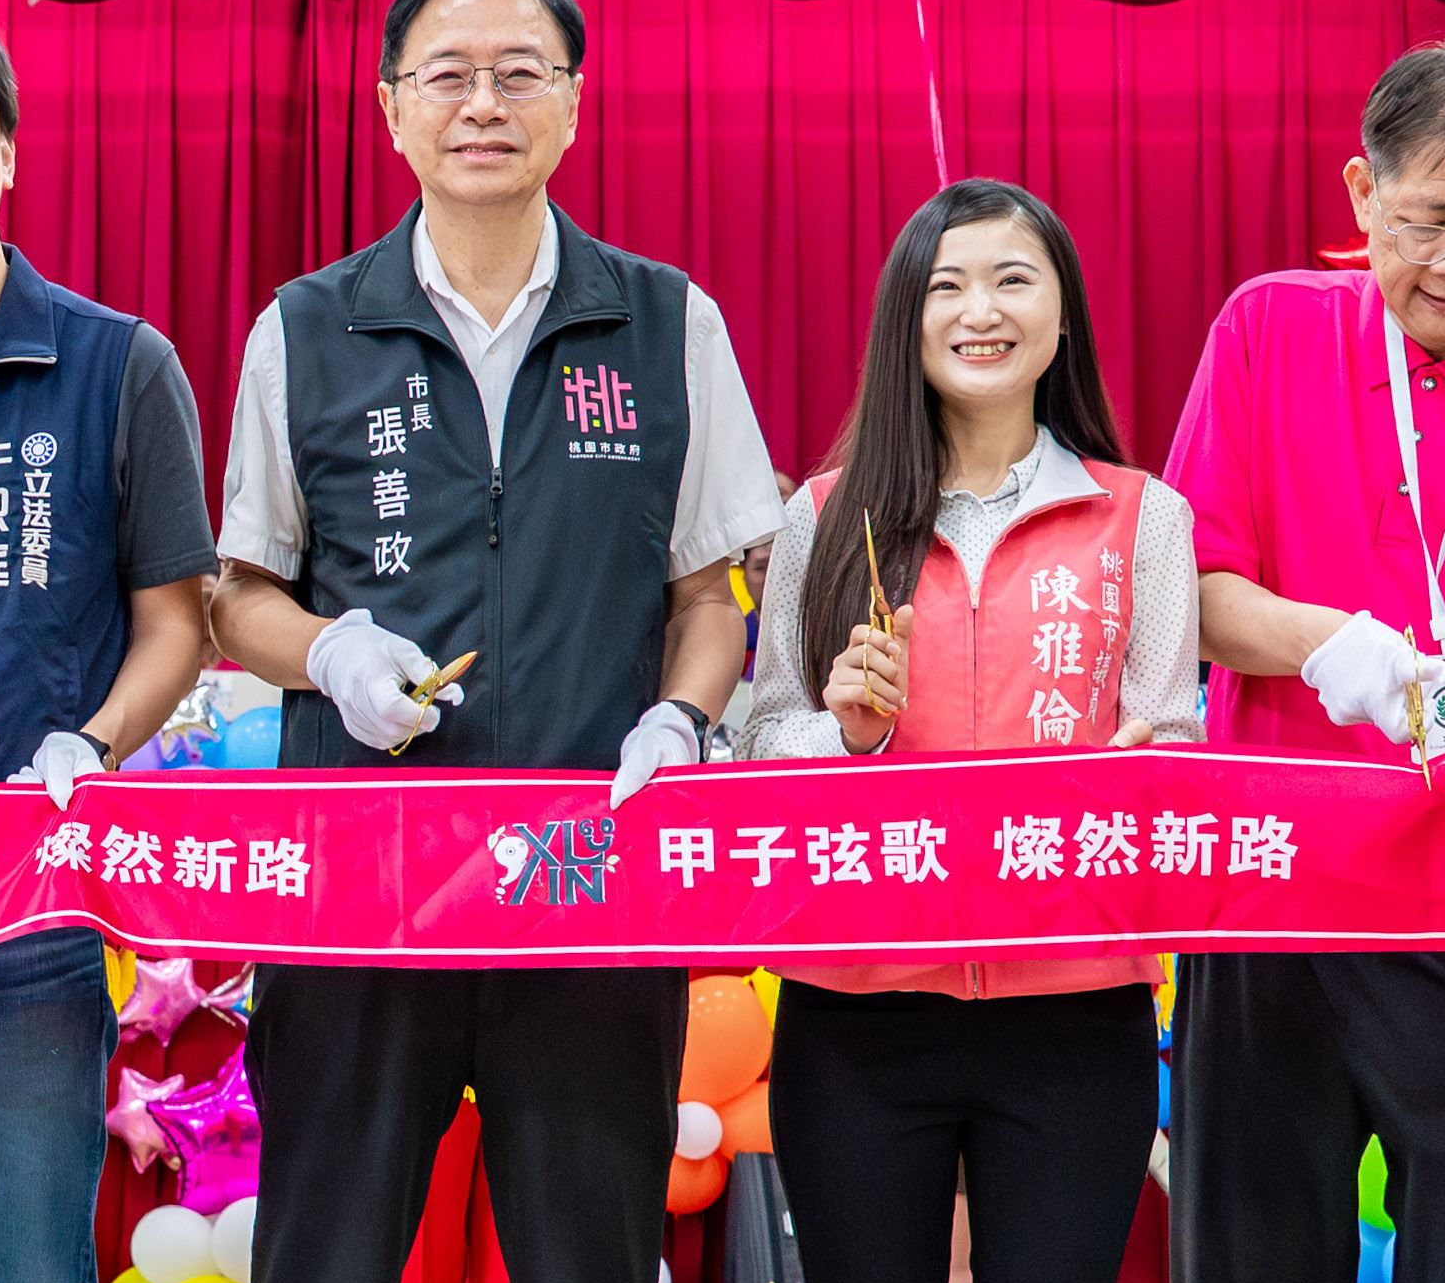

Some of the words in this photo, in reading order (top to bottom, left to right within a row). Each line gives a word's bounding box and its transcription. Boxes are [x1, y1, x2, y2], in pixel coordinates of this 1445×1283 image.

[406, 373, 433, 432] 市長
[568, 440, 641, 457] 桃園市政府
[20, 469, 53, 591] 立法委員
[366, 407, 413, 577] 張善政
[1026, 564, 1091, 747] 陳雅倫
[35, 821, 312, 898] 燦然新路
[658, 821, 948, 889] 甲子弦歌
[993, 809, 1299, 882] 燦然新路
